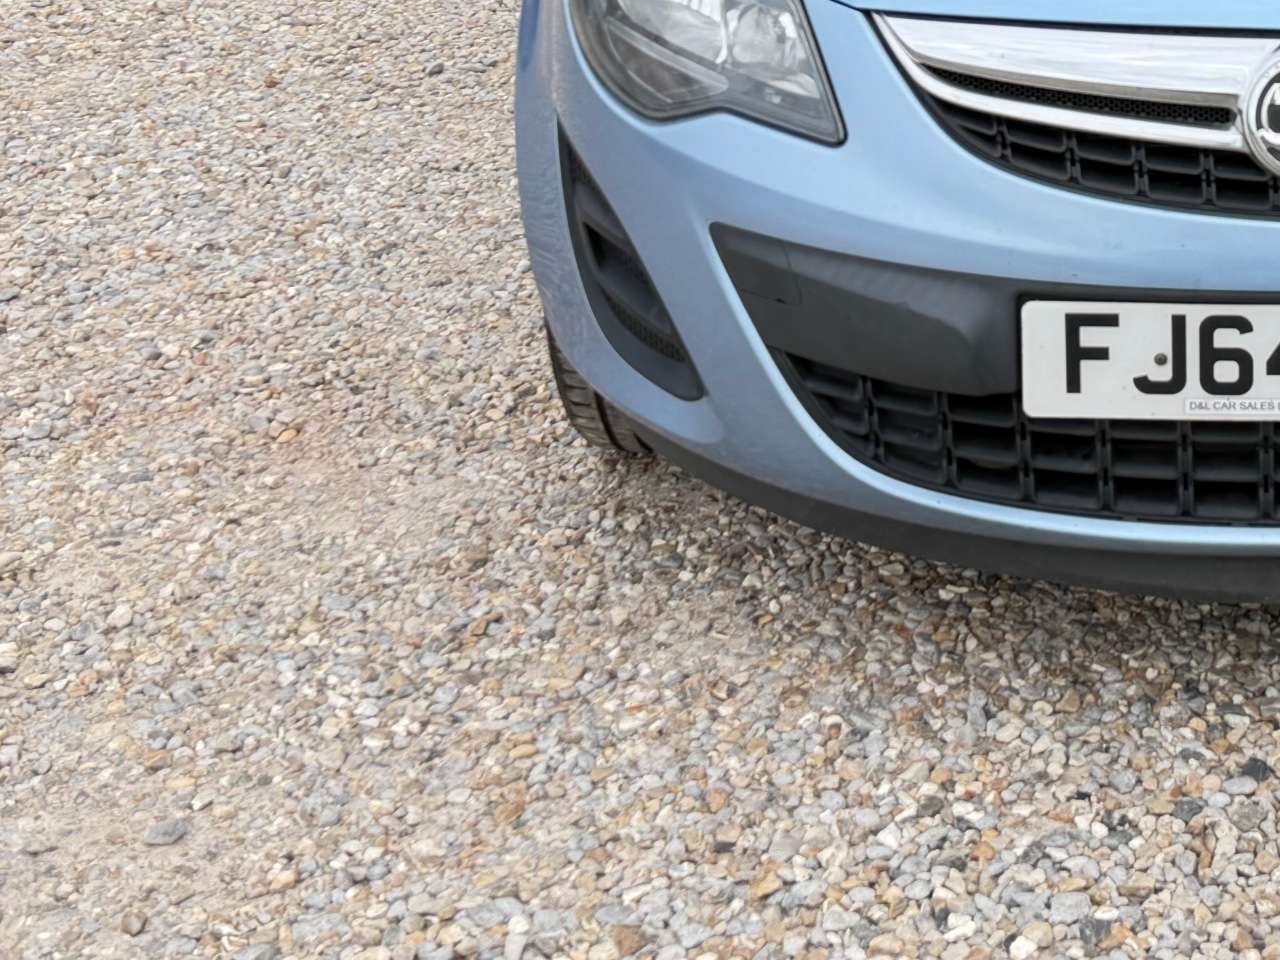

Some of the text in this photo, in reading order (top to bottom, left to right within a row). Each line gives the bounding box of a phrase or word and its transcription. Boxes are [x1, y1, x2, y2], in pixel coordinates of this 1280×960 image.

[1189, 400, 1210, 410] D&L
[1213, 400, 1237, 410] CAR
[1239, 400, 1275, 410] SALES
